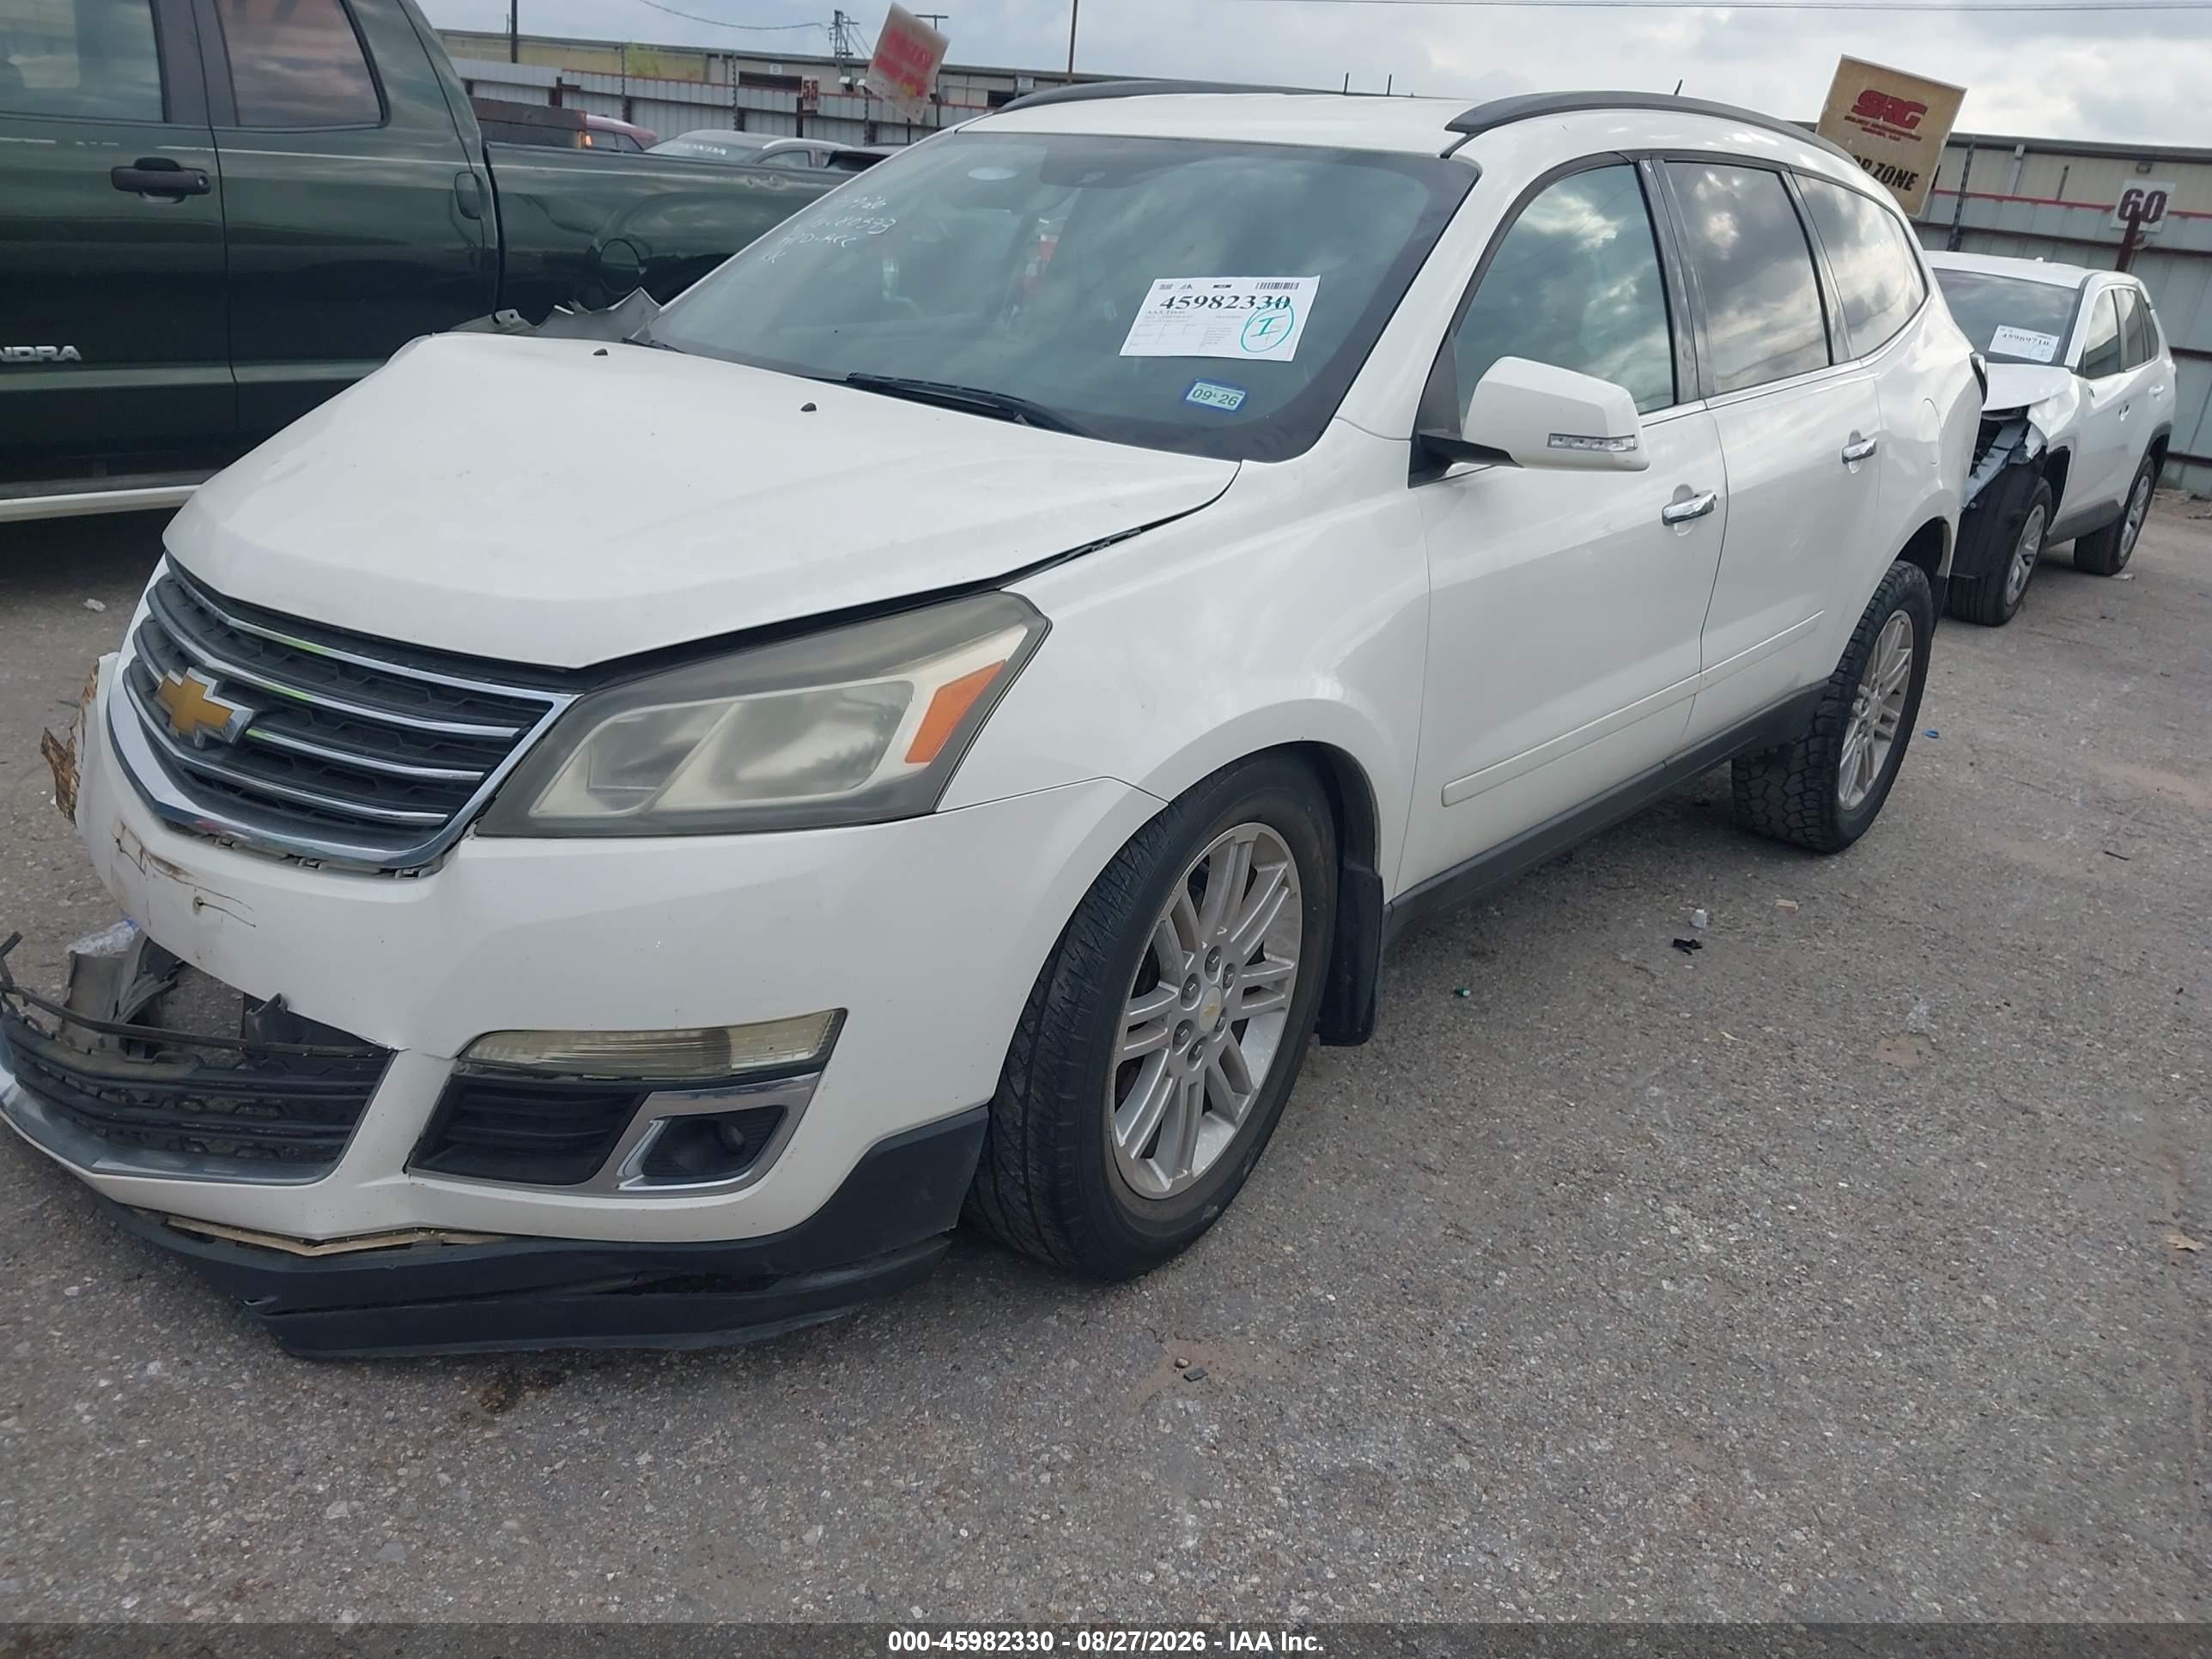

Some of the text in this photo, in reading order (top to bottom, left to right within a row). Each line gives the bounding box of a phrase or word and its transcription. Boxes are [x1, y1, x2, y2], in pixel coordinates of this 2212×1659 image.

[1872, 161, 1919, 191] ZONE
[2117, 188, 2167, 224] 60
[1159, 295, 1291, 309] 45982330
[1192, 389, 1212, 400] 09
[1218, 394, 1240, 406] 26
